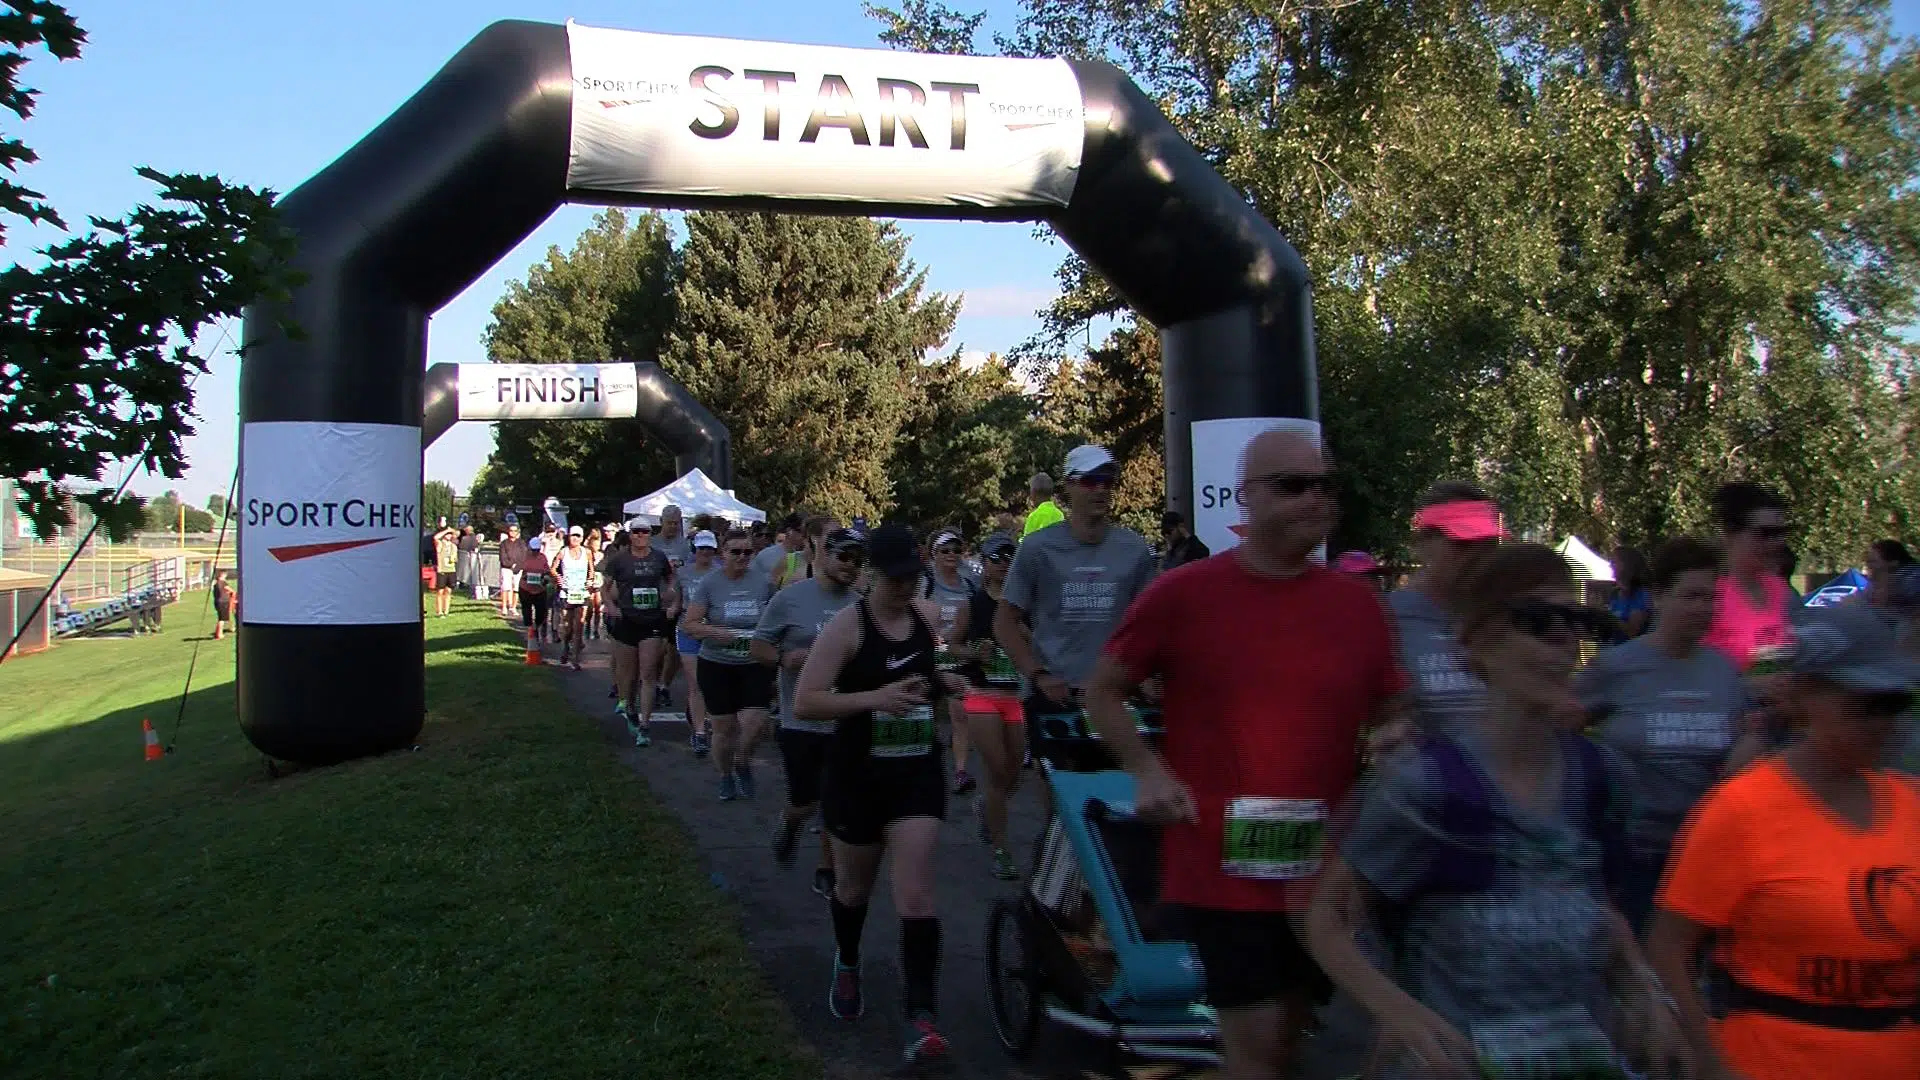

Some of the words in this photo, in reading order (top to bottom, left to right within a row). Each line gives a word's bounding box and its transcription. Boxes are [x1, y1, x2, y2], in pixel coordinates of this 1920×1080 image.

[688, 65, 980, 151] START
[497, 377, 600, 402] FINISH
[248, 498, 415, 528] SPORTCHEK
